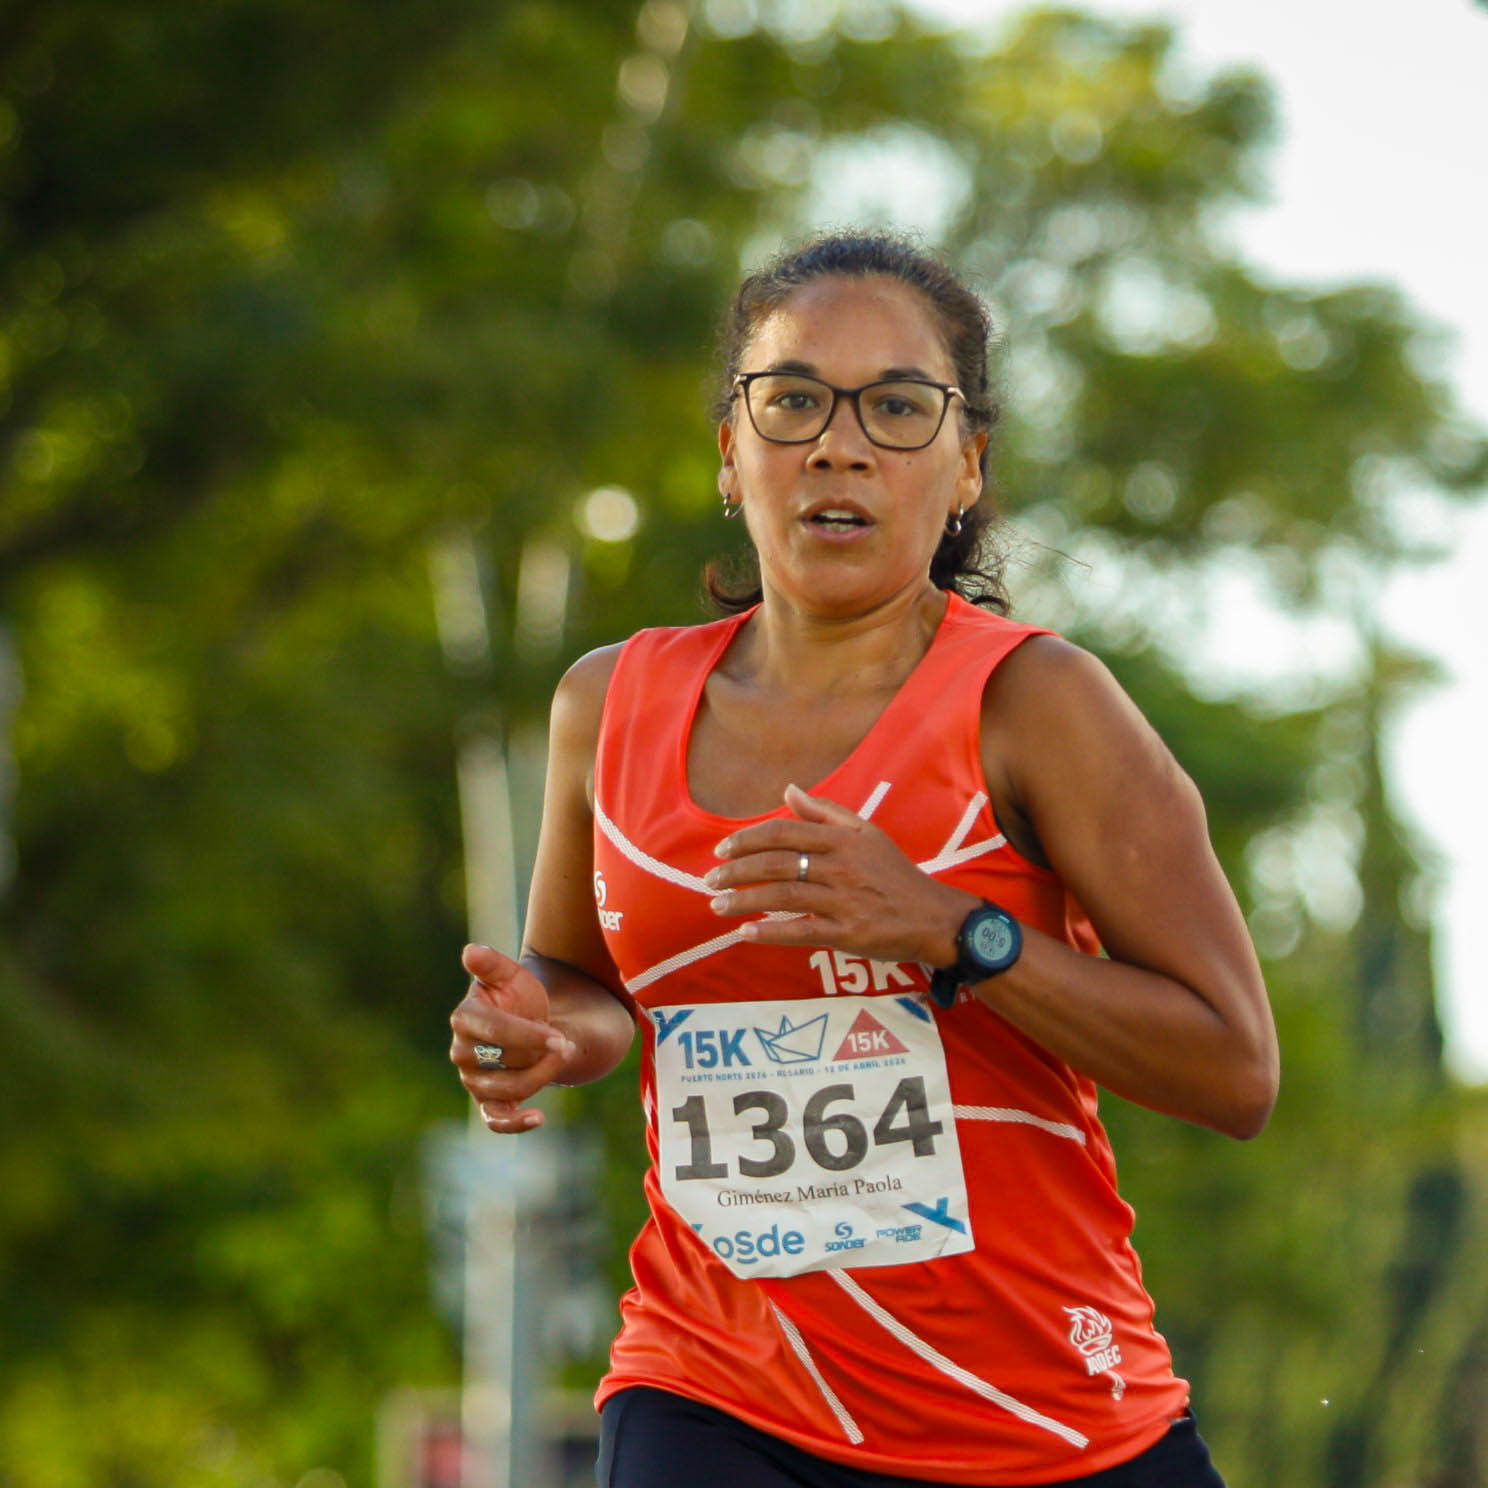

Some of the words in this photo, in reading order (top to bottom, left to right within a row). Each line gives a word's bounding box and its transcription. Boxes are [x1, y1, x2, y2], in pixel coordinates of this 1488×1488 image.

[809, 950, 915, 995] 15K
[678, 1028, 752, 1069] 15K
[847, 1030, 890, 1053] 15K
[672, 1076, 943, 1181] 1364
[717, 1189, 791, 1207] Giménez
[797, 1181, 849, 1200] María
[855, 1175, 902, 1194] Paola
[713, 1224, 805, 1259] osde
